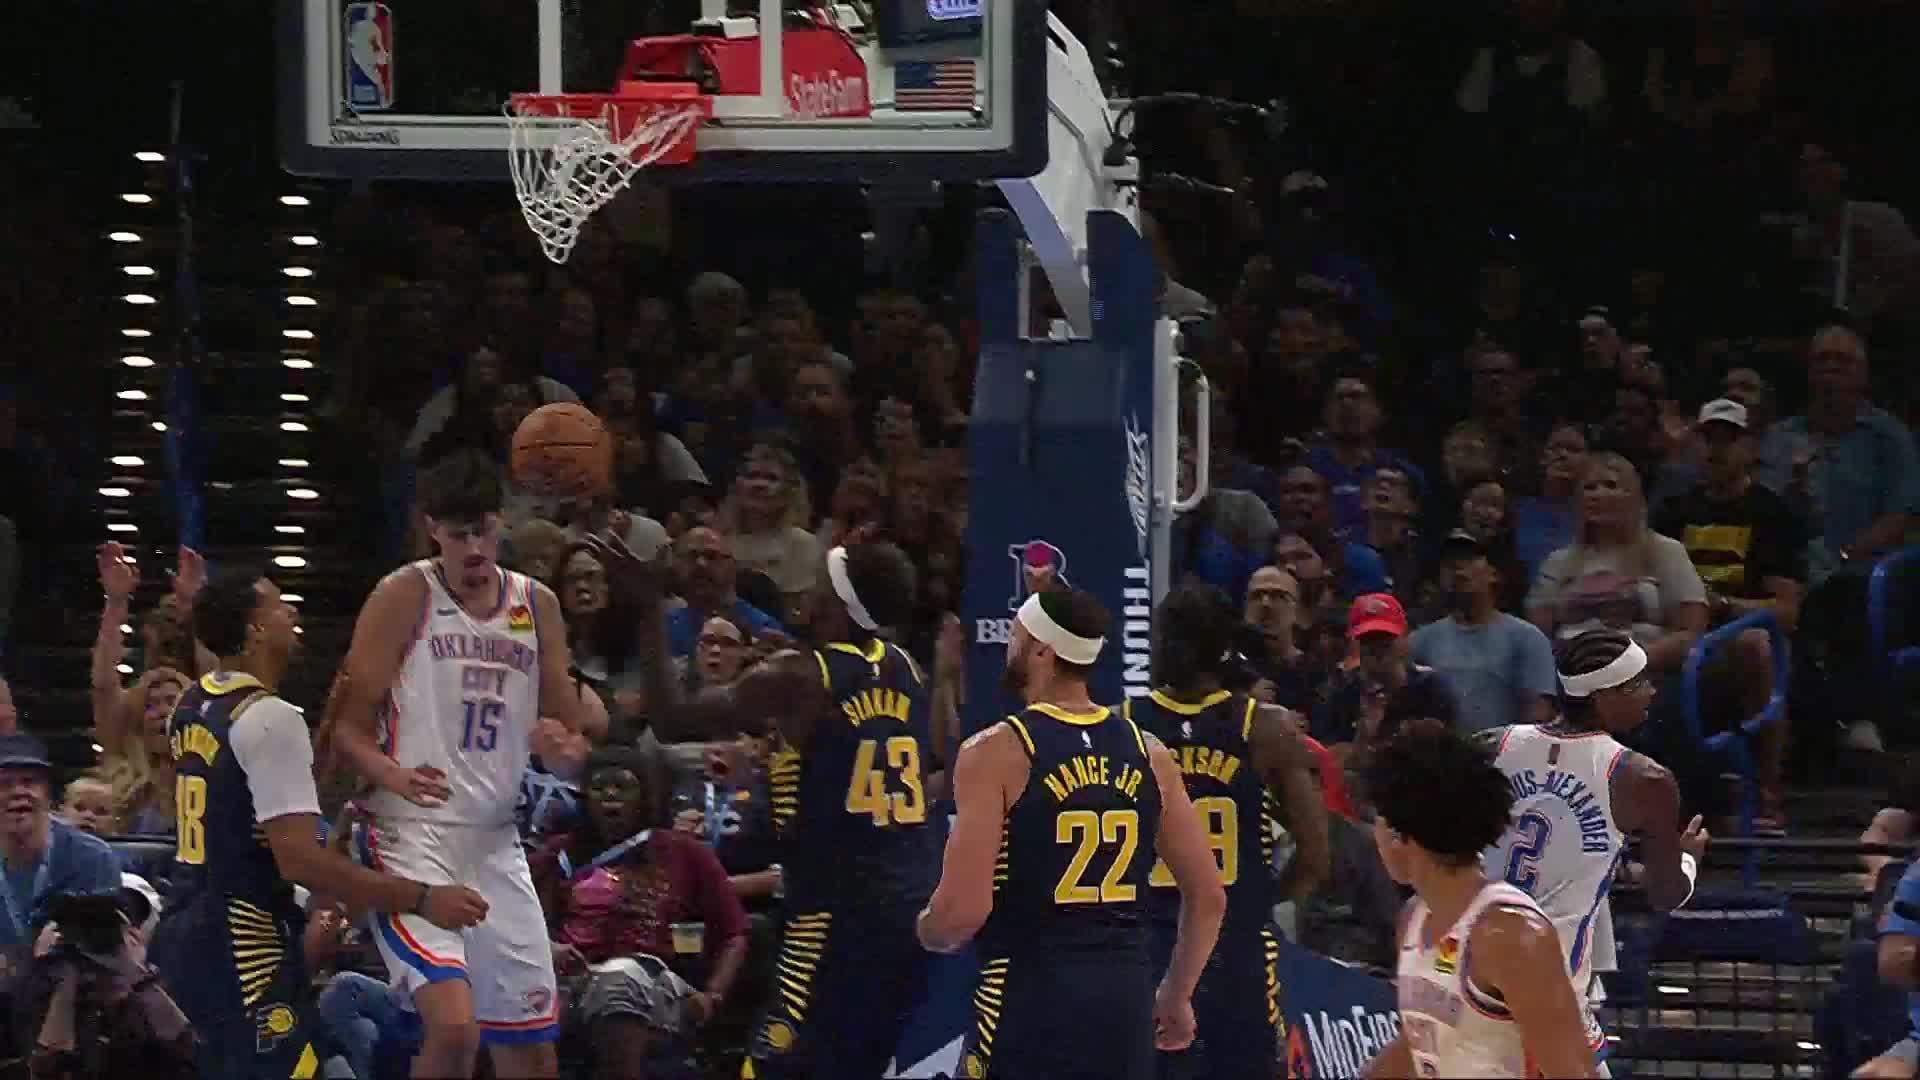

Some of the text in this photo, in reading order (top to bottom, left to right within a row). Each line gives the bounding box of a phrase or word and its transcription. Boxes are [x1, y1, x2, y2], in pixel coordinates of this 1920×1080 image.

[462, 699, 505, 753] 15
[845, 736, 926, 827] 43
[1043, 756, 1109, 802] NANCE
[1055, 810, 1139, 904] 22
[1503, 808, 1553, 891] 2
